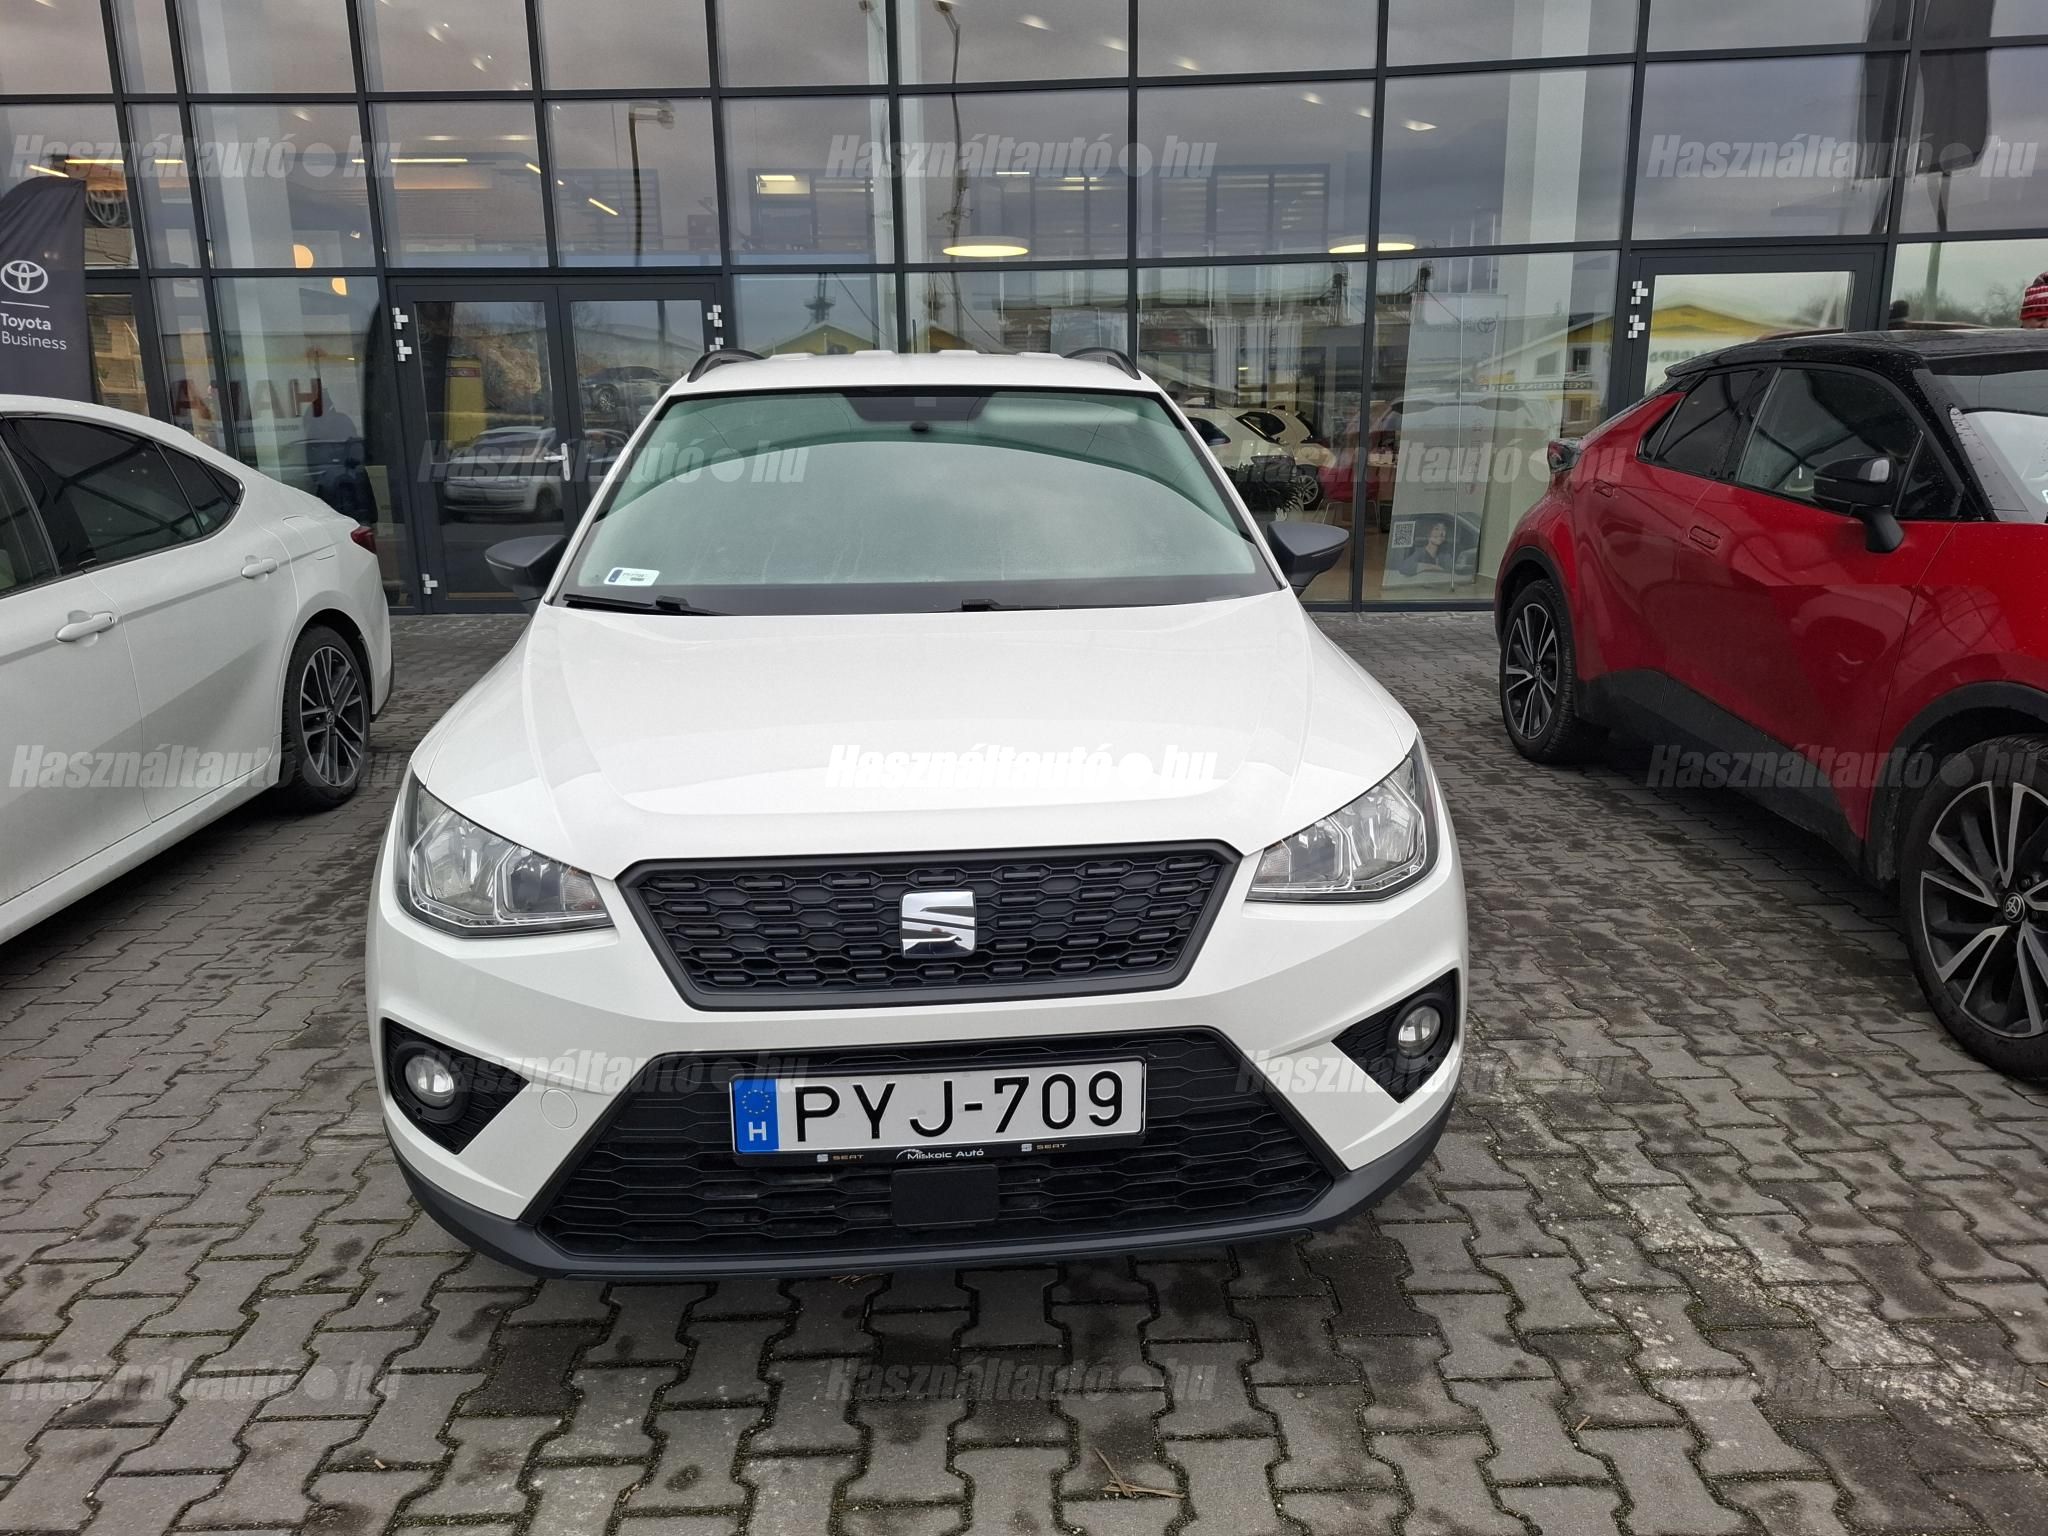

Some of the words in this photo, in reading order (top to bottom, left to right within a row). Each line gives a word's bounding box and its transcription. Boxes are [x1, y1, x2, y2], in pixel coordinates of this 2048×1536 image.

[0, 312, 52, 331] Toyota
[1, 331, 67, 350] Business
[795, 1070, 1123, 1142] PYJ-709
[748, 1121, 767, 1142] H
[955, 1148, 984, 1158] Autó
